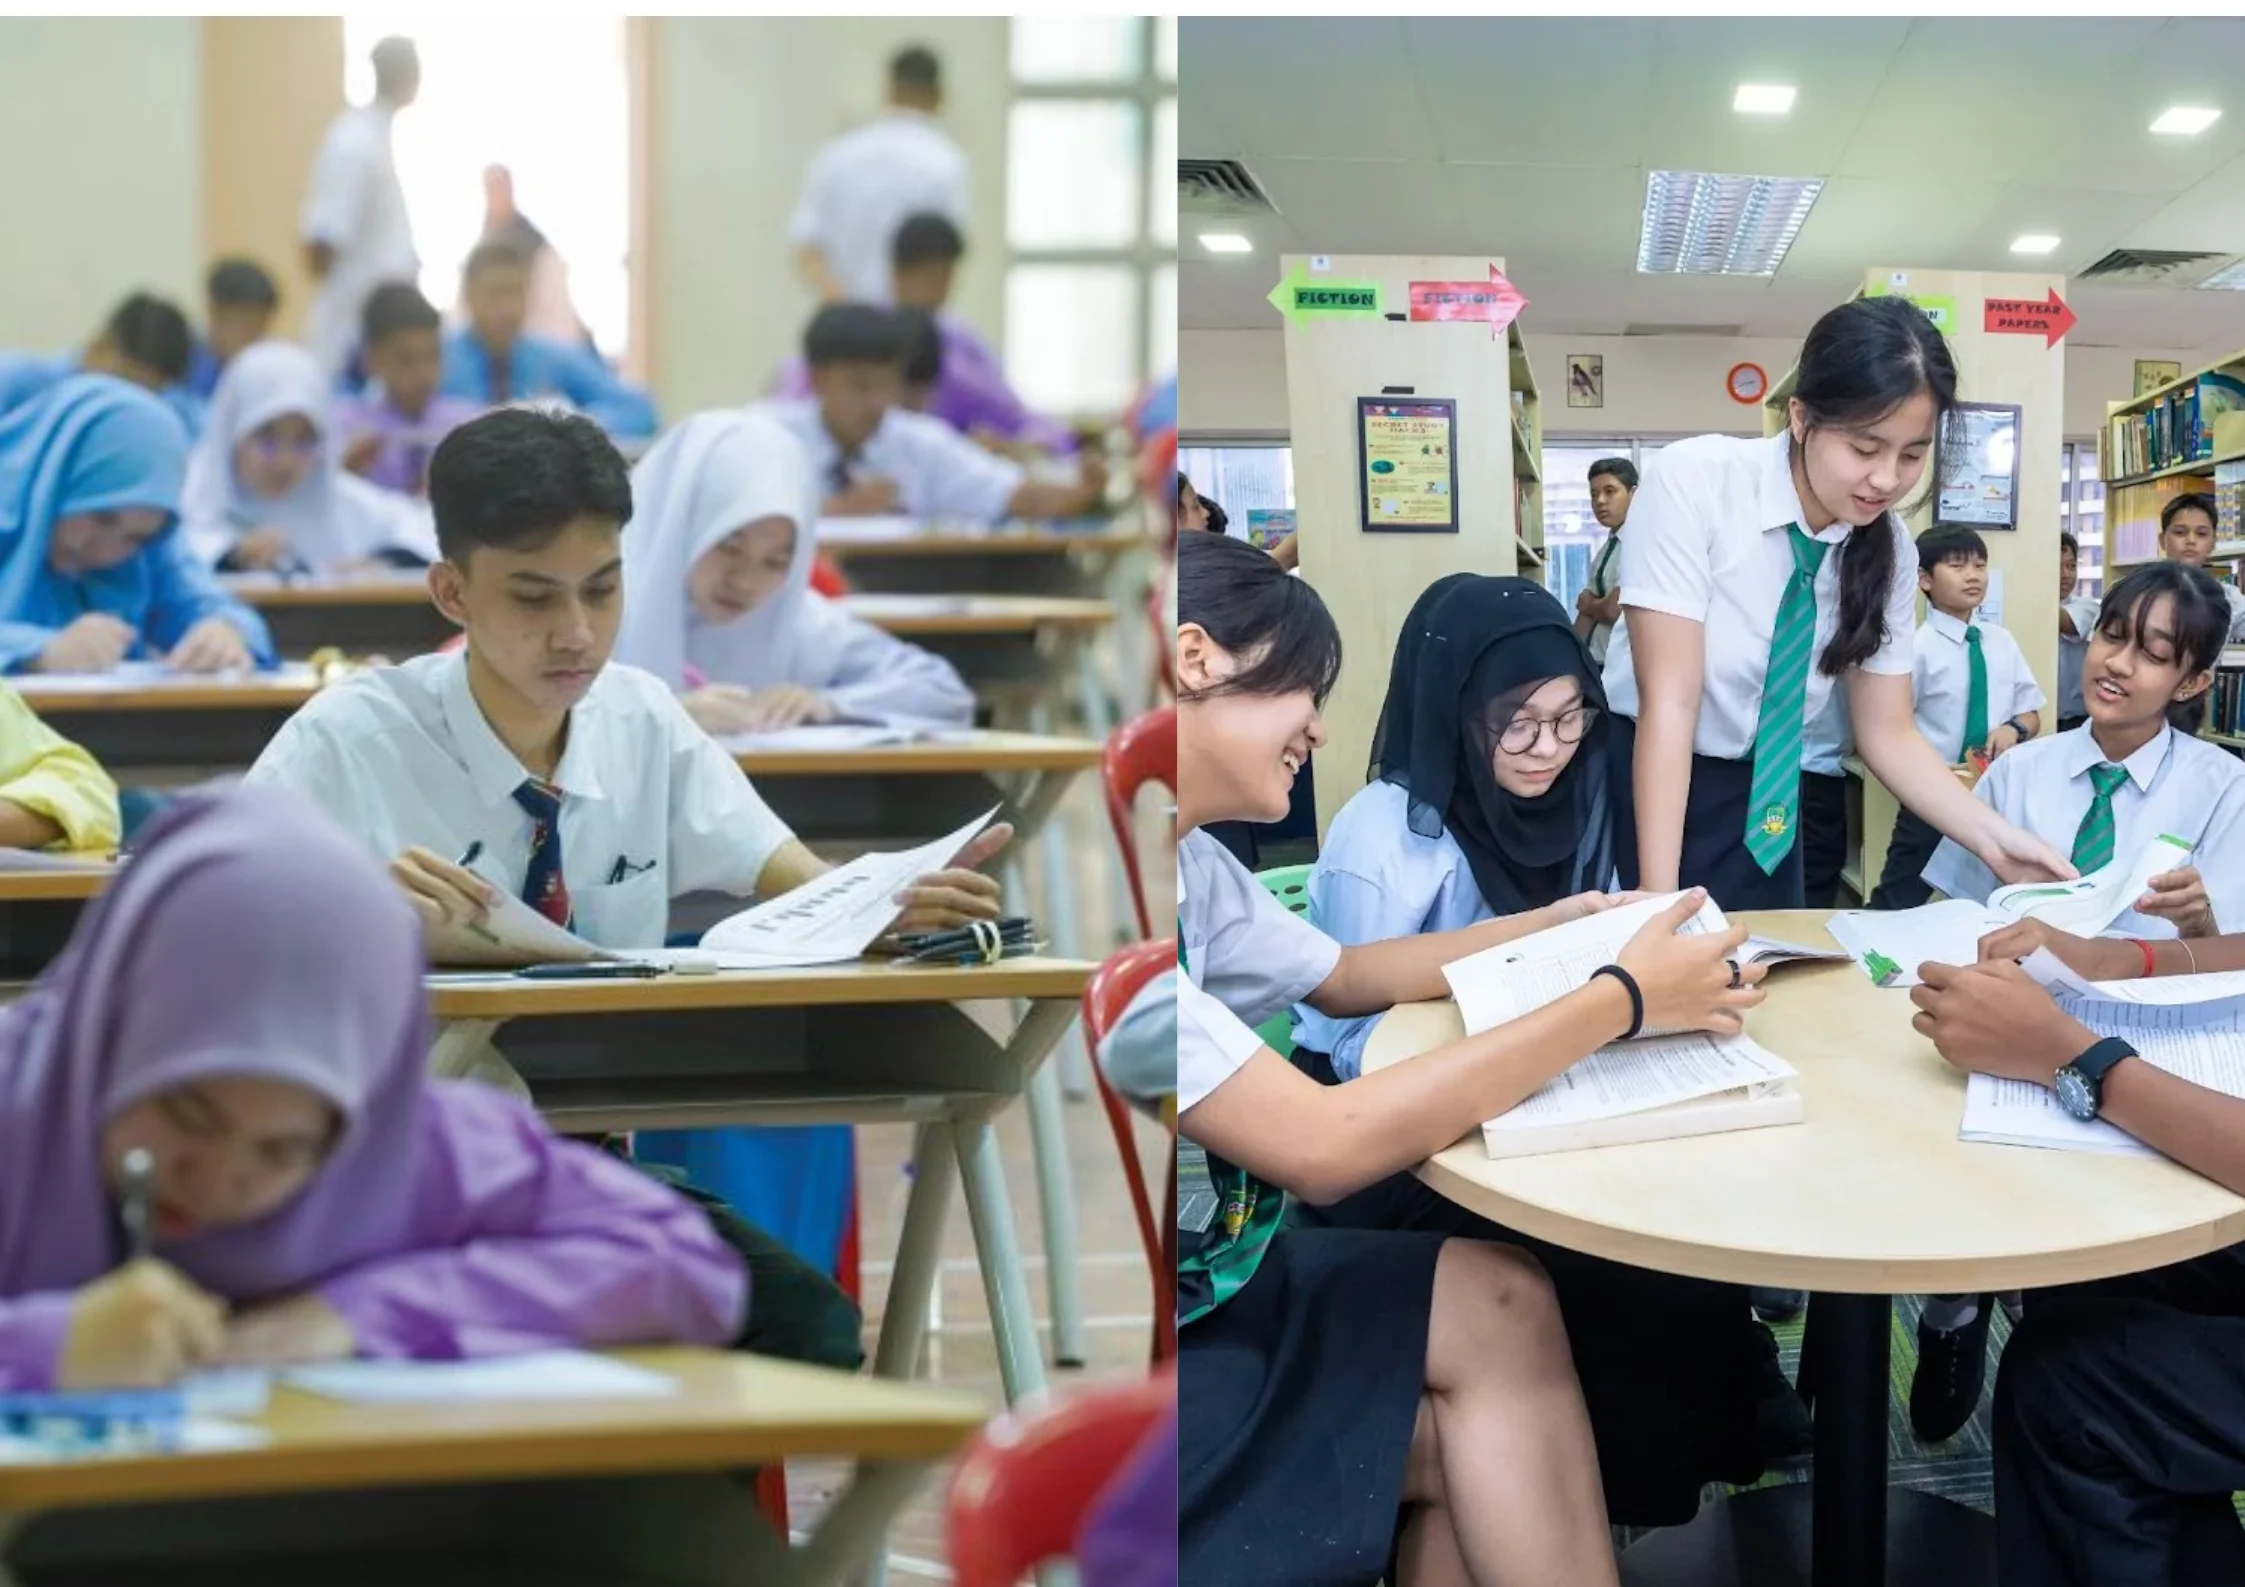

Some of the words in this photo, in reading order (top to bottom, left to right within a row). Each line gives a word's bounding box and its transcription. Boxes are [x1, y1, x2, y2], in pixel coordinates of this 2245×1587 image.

[1297, 291, 1374, 306] FICTION
[1422, 292, 1497, 305] FICTION
[1987, 302, 2021, 313] PAST
[2026, 303, 2061, 315] YEAR
[1998, 318, 2049, 330] PAPERS
